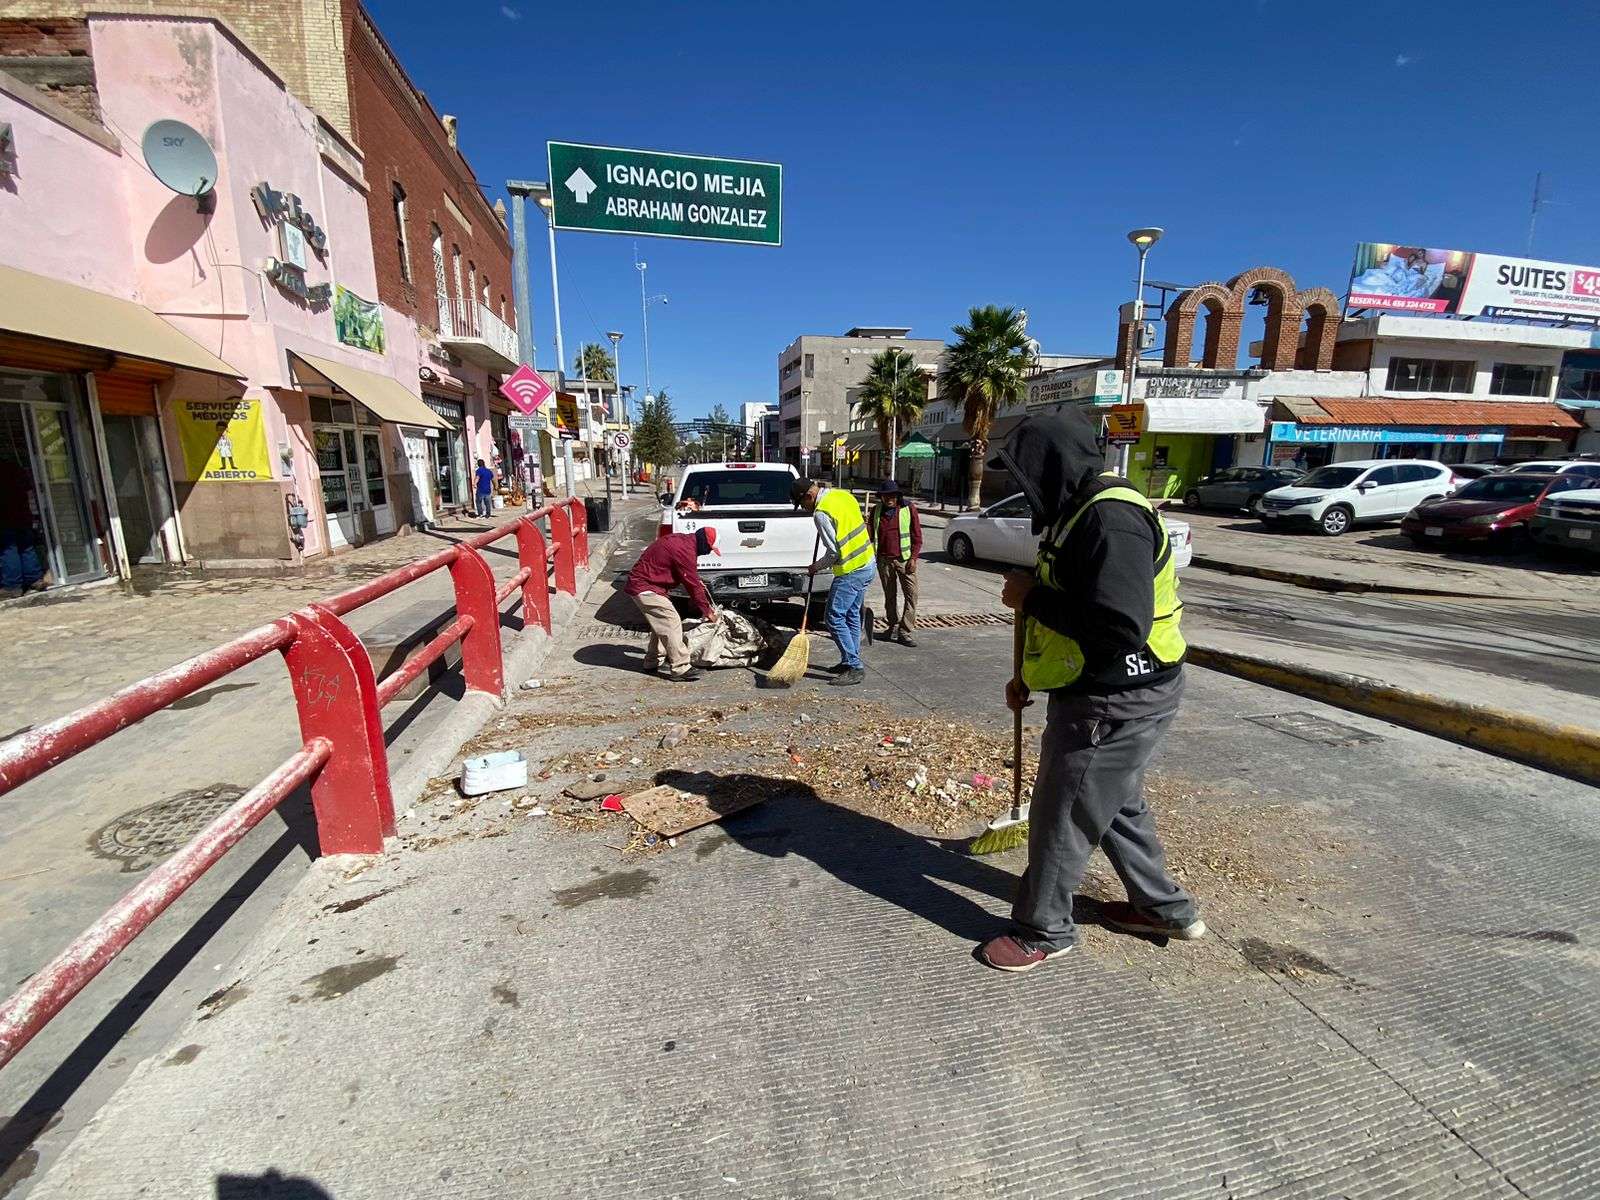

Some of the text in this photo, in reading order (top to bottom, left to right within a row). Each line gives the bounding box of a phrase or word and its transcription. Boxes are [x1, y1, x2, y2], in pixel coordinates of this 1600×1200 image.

[163, 137, 185, 148] SKY
[606, 163, 766, 198] IGNACIO MEJIA
[605, 197, 767, 229] ABRAHAM GONZALEZ
[1496, 264, 1566, 291] SUITES
[1349, 296, 1382, 306] RESERVA
[1040, 380, 1073, 393] STARBUCKS
[1040, 390, 1060, 401] COFFEE
[186, 401, 251, 411] SERVICIOS
[1295, 428, 1383, 442] VETERINARIA
[204, 470, 257, 480] ABIERTO
